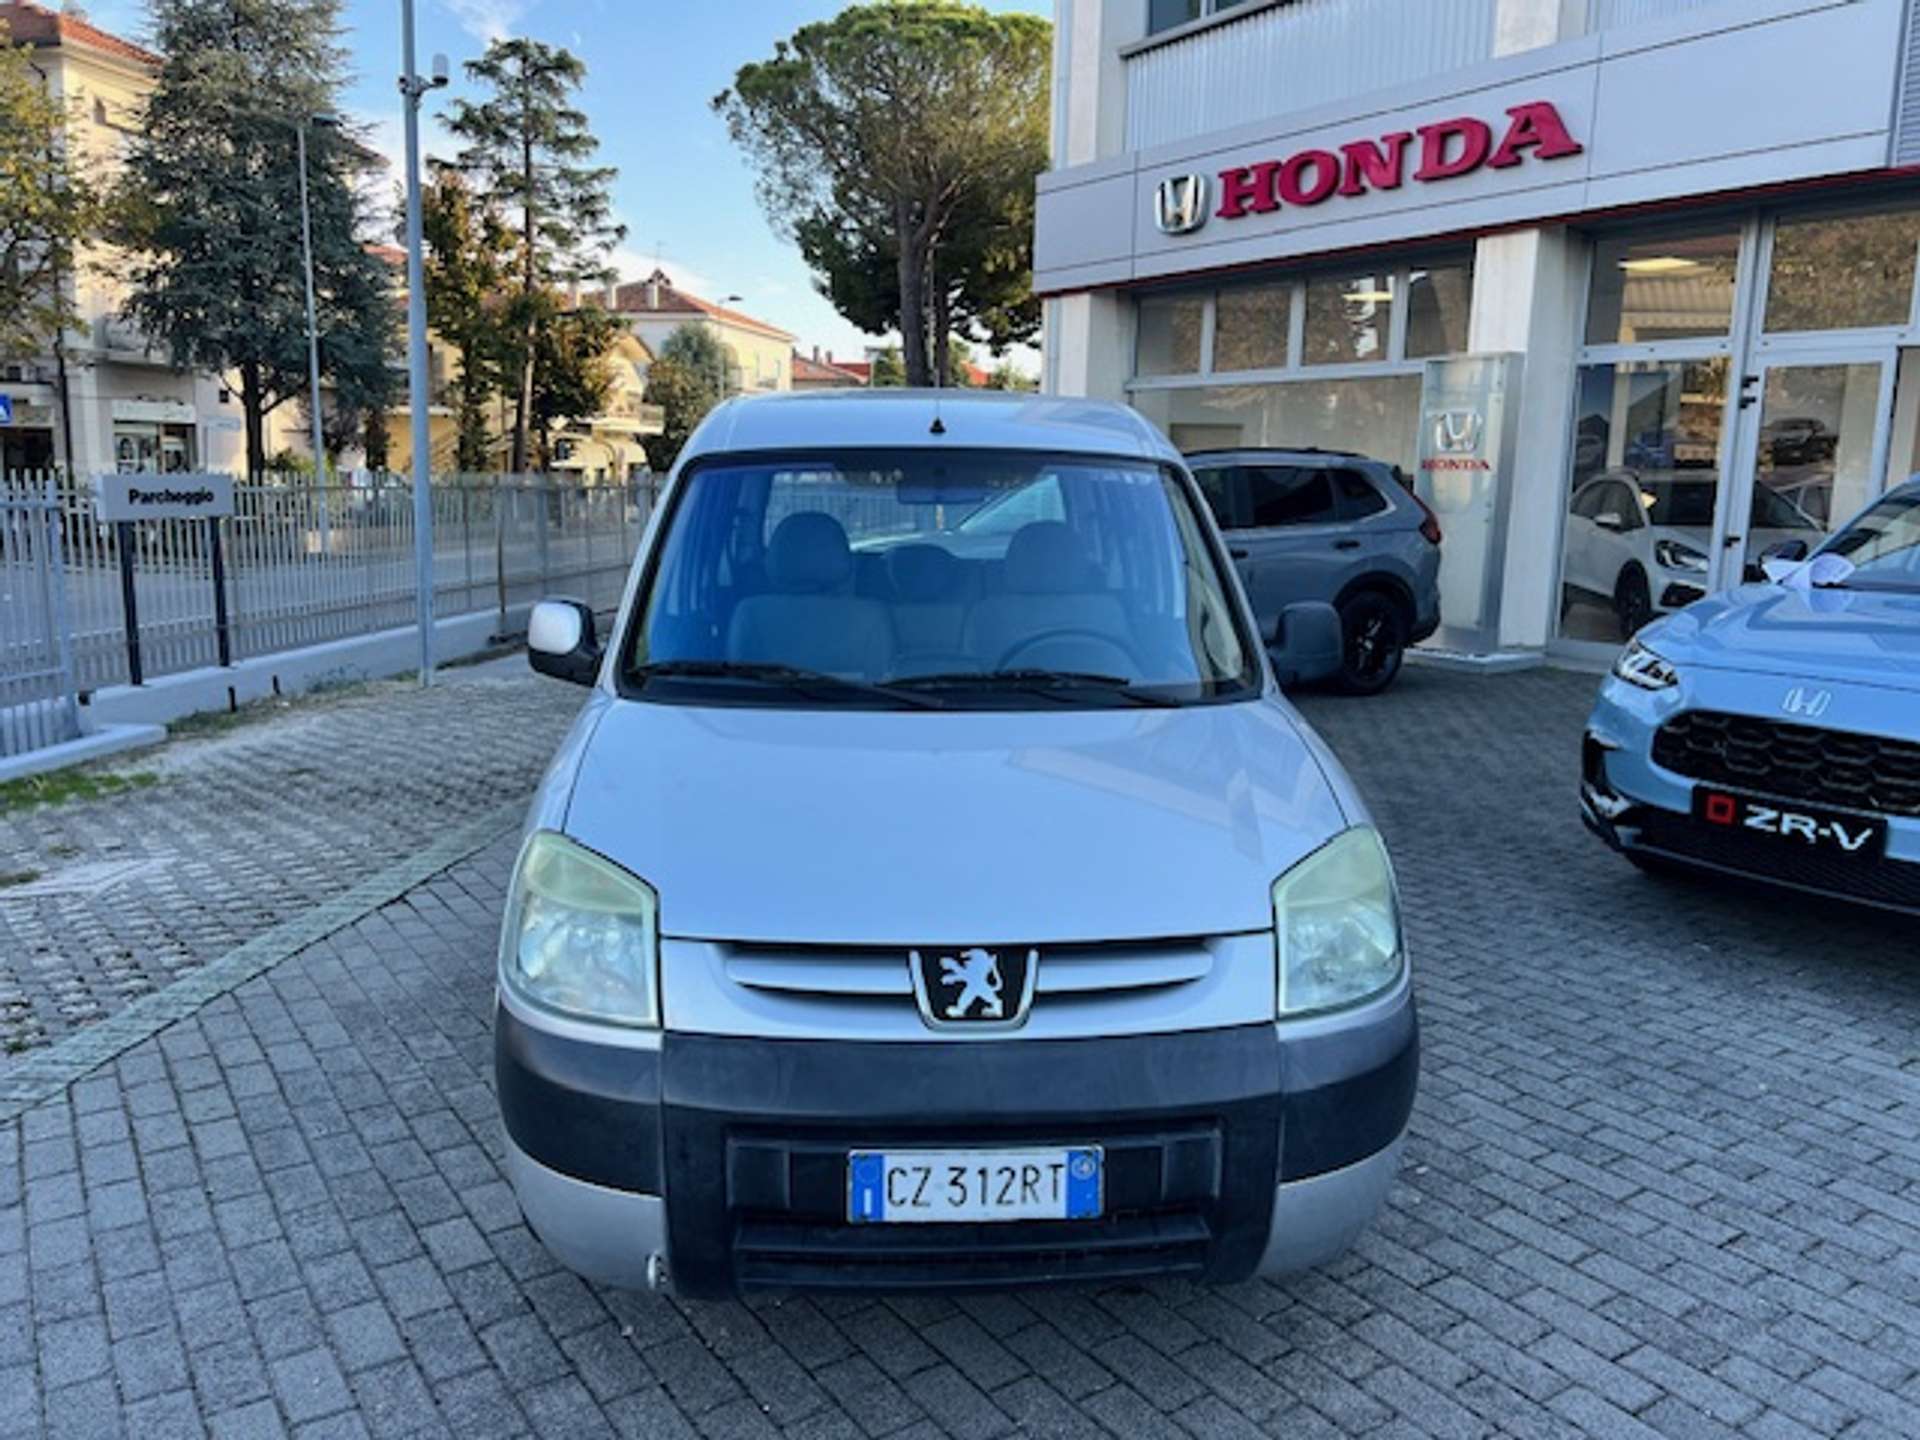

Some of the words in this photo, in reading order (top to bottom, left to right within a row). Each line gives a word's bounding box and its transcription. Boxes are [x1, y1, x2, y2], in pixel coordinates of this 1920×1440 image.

[1217, 101, 1583, 219] HONDA
[1421, 458, 1490, 471] HONDA
[128, 488, 215, 506] Parcheggio
[1743, 803, 1874, 850] ZR-V
[886, 1166, 933, 1208] CZ
[947, 1163, 1065, 1207] 312RT
